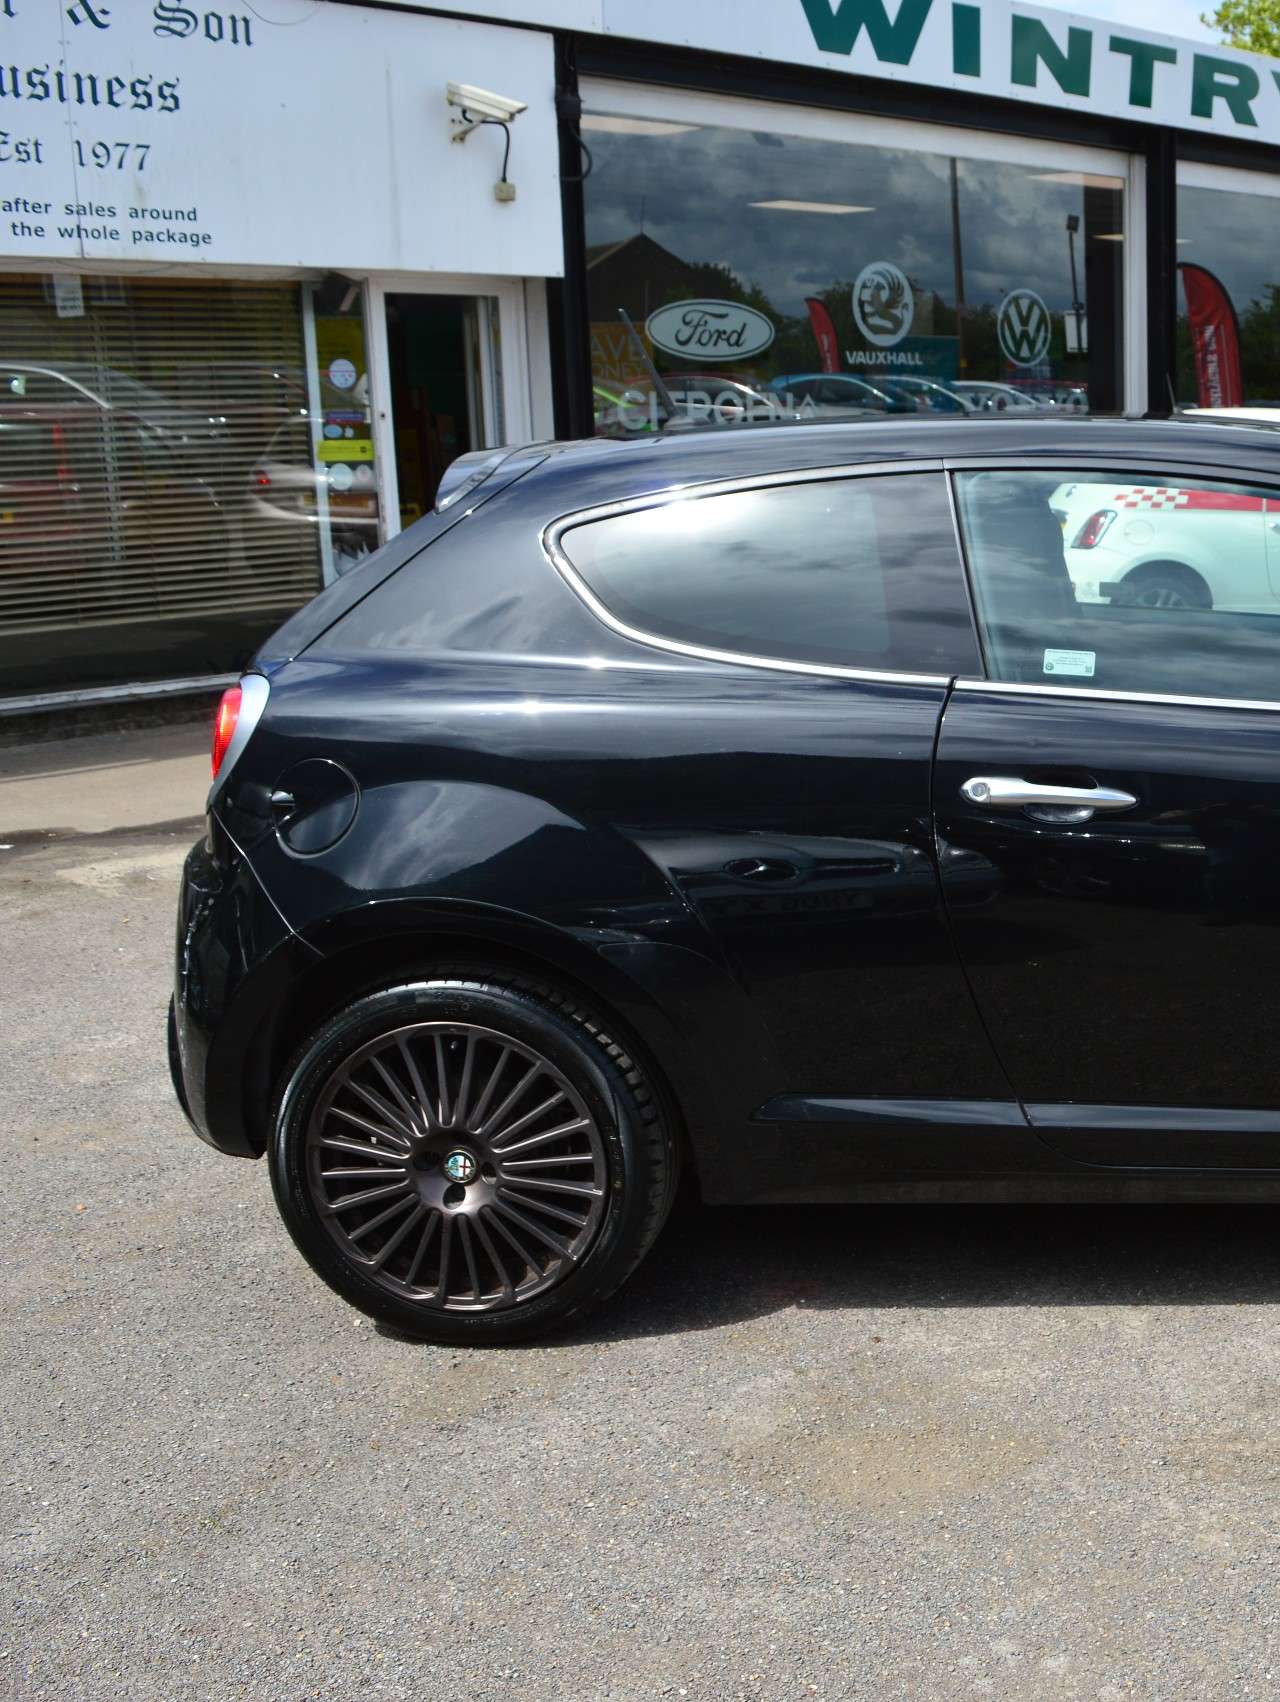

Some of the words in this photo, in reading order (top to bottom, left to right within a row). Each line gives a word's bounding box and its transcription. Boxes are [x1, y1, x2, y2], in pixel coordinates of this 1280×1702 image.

[153, 0, 253, 46] Son
[73, 139, 152, 171] 1977
[1, 197, 52, 214] after
[64, 201, 117, 217] sales
[128, 206, 197, 221] around
[11, 221, 45, 237] the
[57, 224, 120, 240] whole
[132, 228, 212, 247] package
[674, 309, 748, 348] Ford
[845, 350, 924, 366] VAUXHALL
